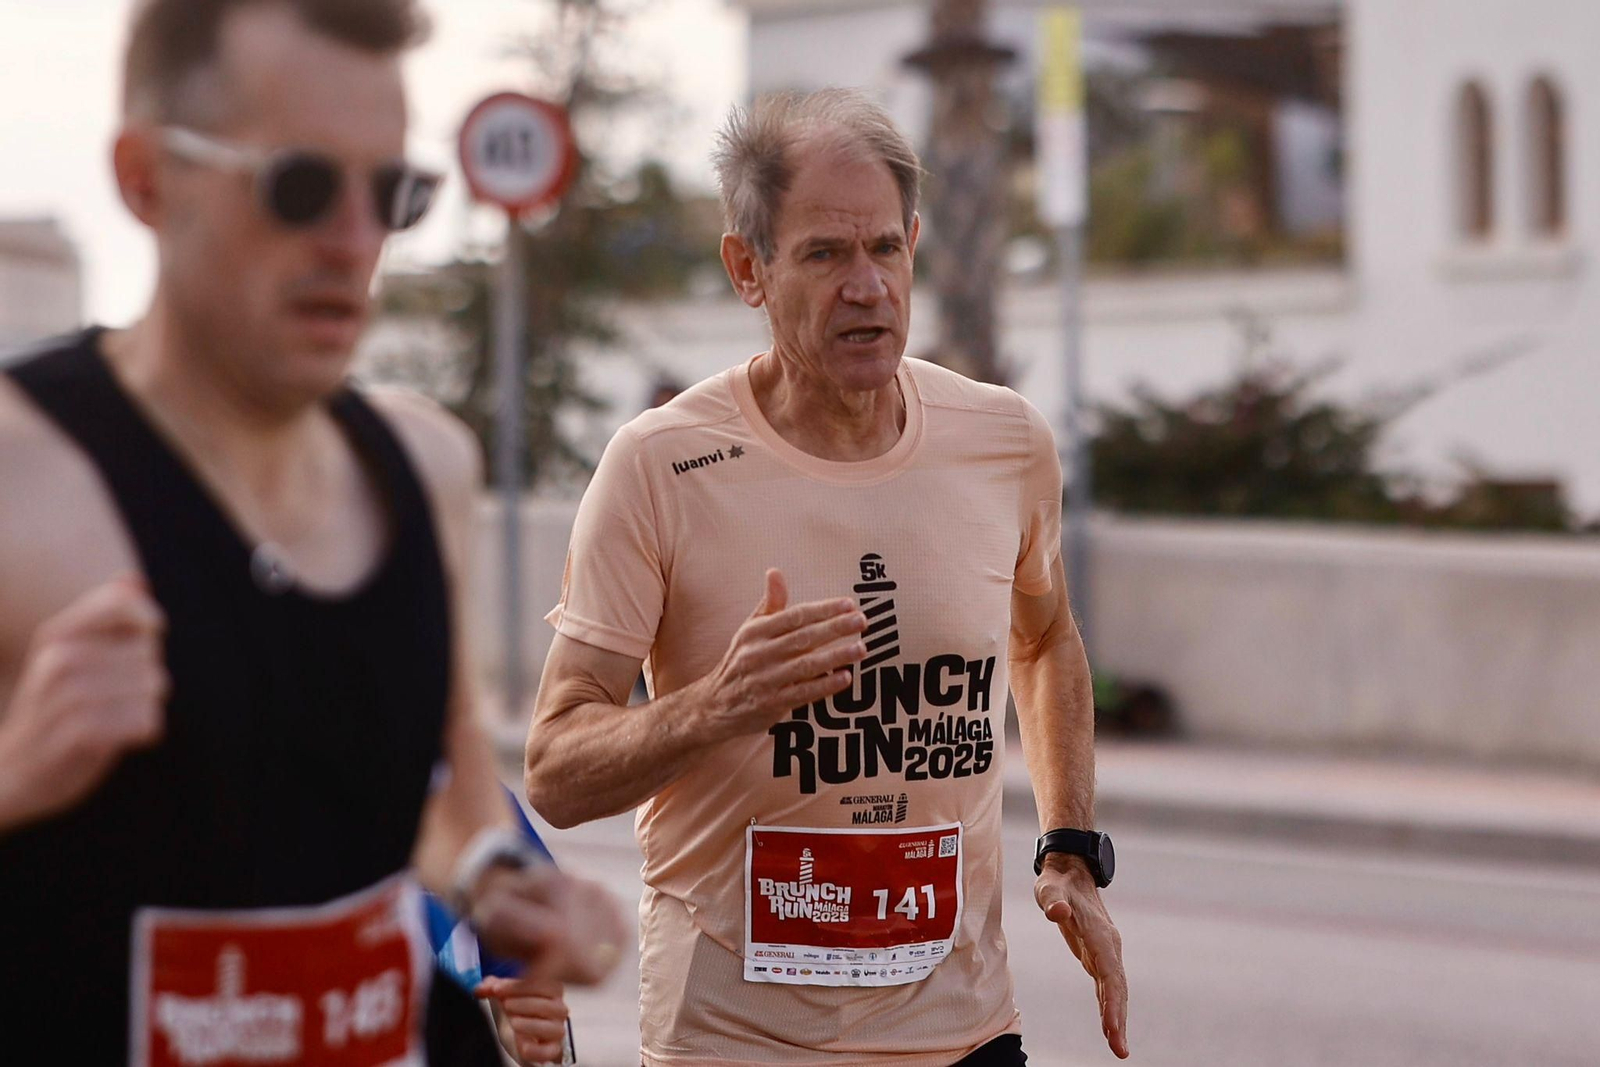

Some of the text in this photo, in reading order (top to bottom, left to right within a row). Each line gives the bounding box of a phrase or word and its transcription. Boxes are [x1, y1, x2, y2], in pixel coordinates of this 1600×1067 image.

[672, 449, 725, 475] luanvi
[908, 712, 993, 747] MÁLAGA
[768, 715, 903, 794] RUN
[905, 741, 994, 781] 2025
[853, 795, 894, 804] GENERALI
[852, 810, 893, 825] MÁLAGA
[757, 878, 852, 904] BRUNCH
[873, 884, 936, 920] 141
[768, 895, 813, 921] RUN
[812, 911, 849, 922] 2025
[814, 901, 849, 912] MÁLAGA
